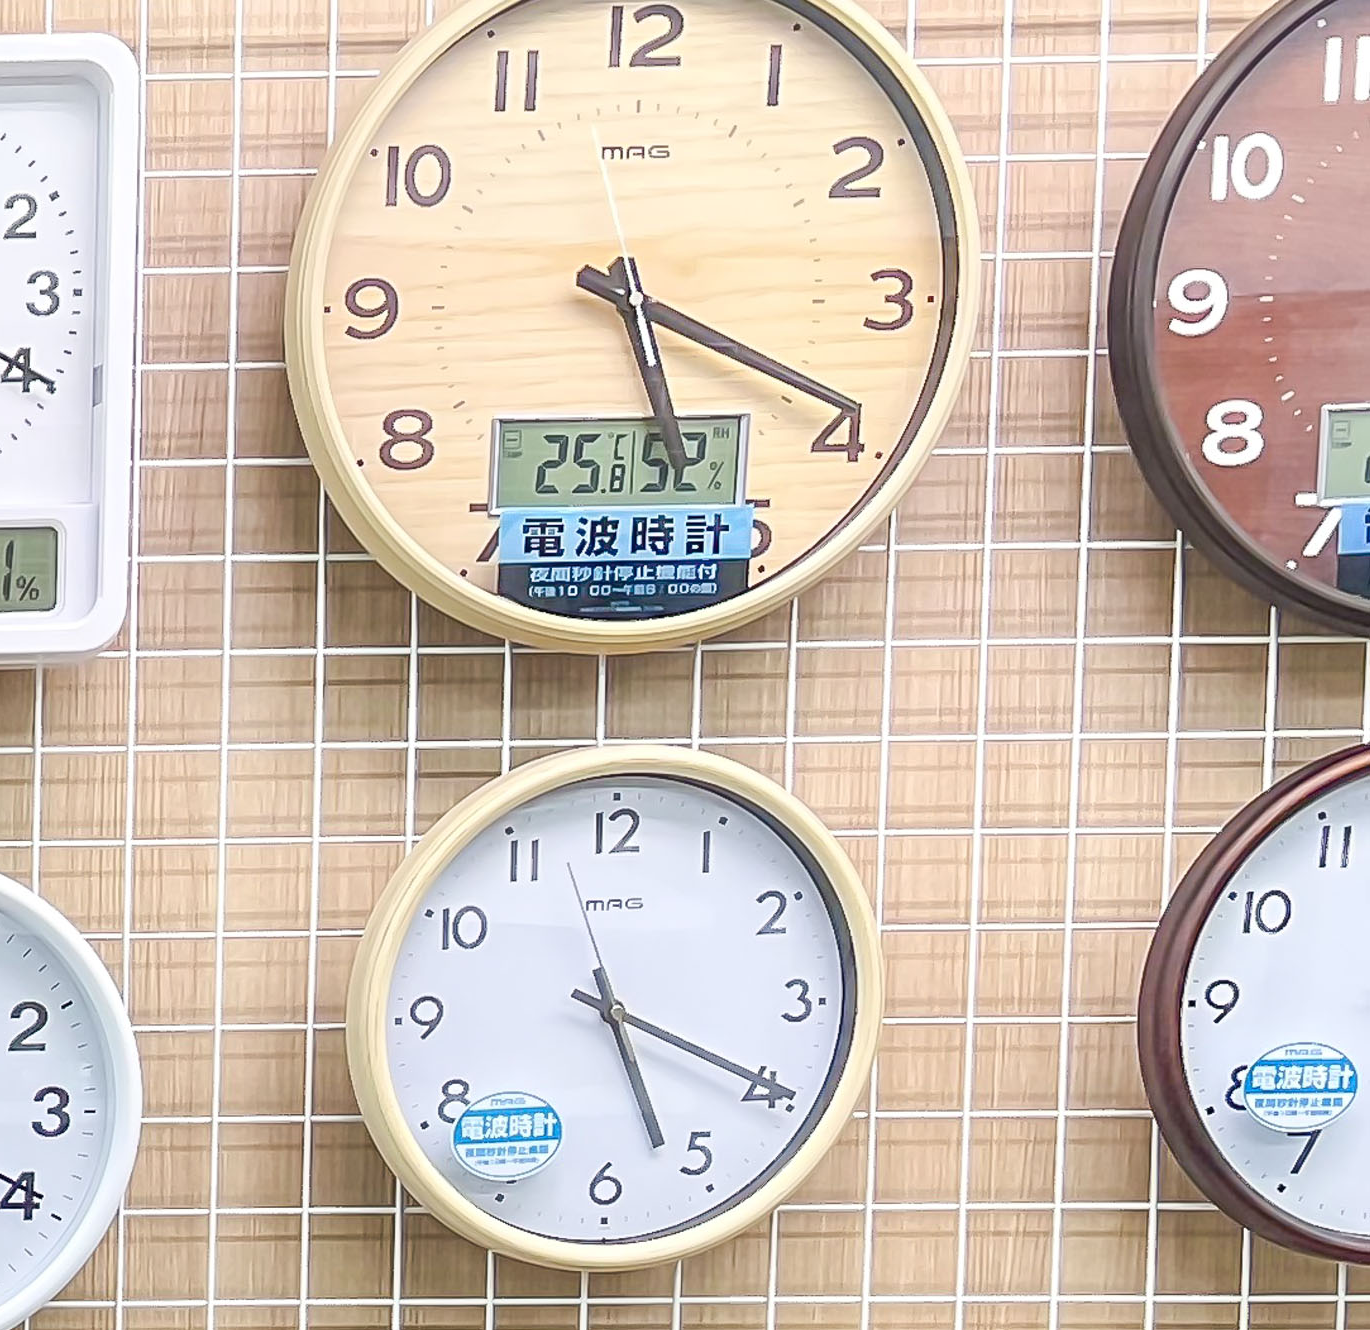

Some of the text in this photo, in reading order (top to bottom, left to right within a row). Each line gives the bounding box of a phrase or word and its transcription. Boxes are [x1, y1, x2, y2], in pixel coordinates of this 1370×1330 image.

[609, 4, 684, 67] 12
[495, 50, 538, 112] 11
[601, 145, 670, 160] MAG
[1211, 133, 1282, 200] 10
[386, 145, 451, 207] 10
[26, 271, 59, 316] 3
[863, 269, 913, 330] 3
[1168, 270, 1228, 335] 9
[1203, 400, 1263, 465] 8
[522, 513, 730, 558] 電波時計
[596, 808, 639, 854] 12
[1319, 826, 1351, 868] 11
[511, 840, 538, 882] 11
[586, 898, 644, 910] MAG
[1243, 890, 1291, 933] 10
[442, 906, 487, 950] 10
[1205, 980, 1239, 1023] 9
[1252, 1065, 1355, 1090] 電波時計
[32, 1087, 70, 1137] 3
[462, 1113, 557, 1140] 電波時計
[590, 1162, 622, 1205] 6
